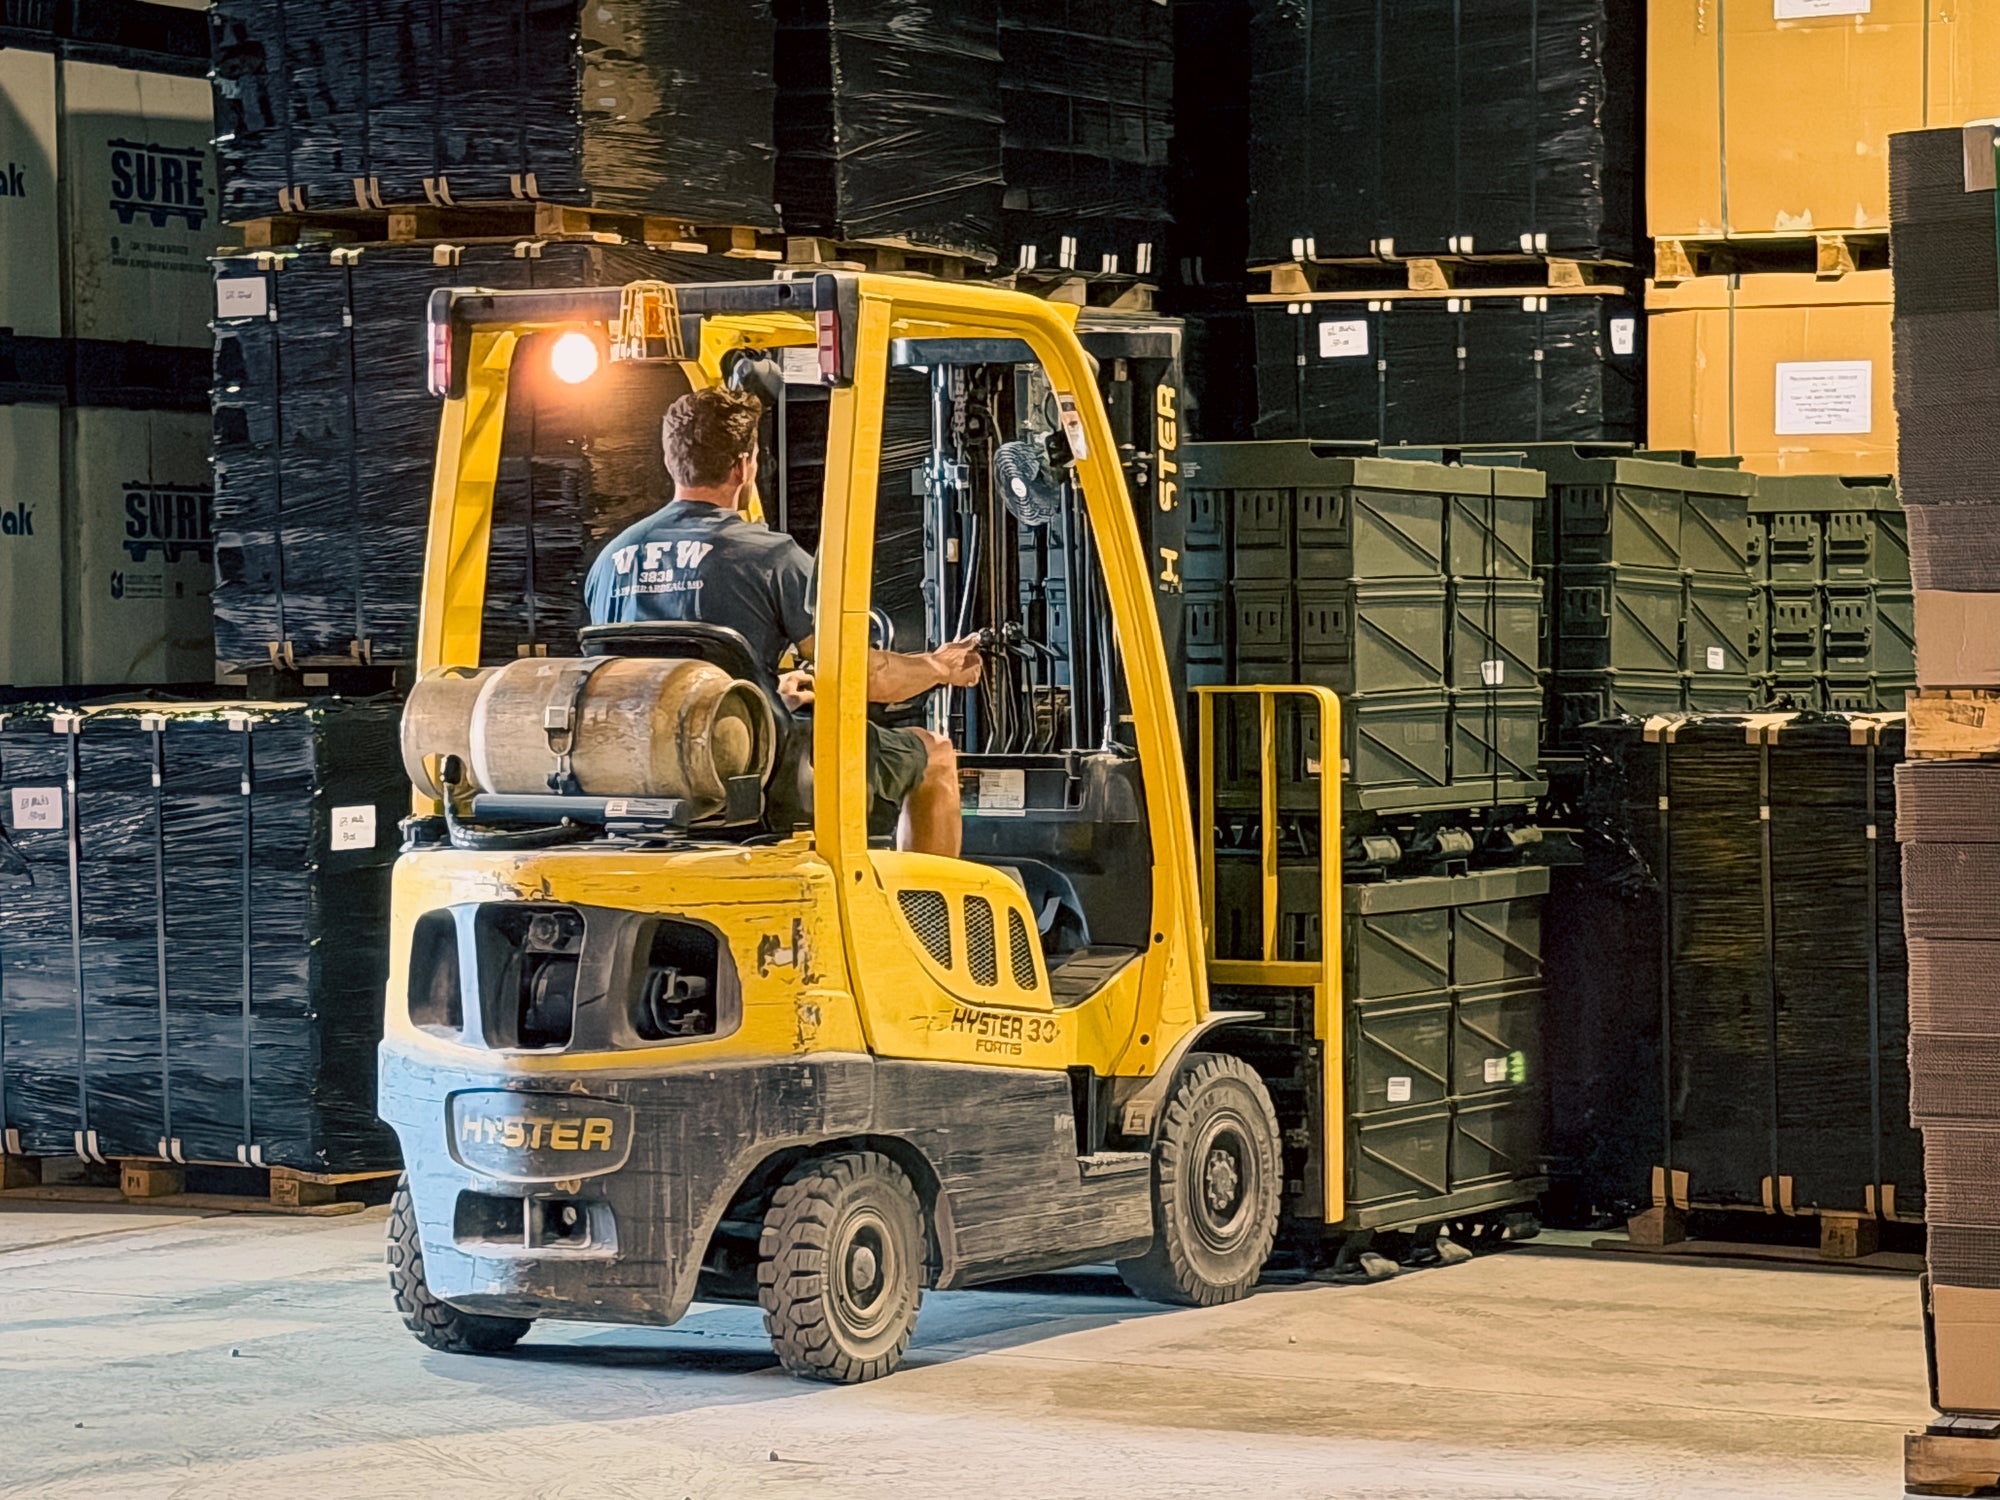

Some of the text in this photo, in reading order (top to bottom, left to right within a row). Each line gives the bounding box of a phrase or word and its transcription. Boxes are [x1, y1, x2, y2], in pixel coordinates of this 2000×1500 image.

[111, 150, 205, 207] SURE
[1156, 383, 1178, 583] HSTER
[0, 502, 34, 536] ak
[611, 541, 713, 574] VFW
[951, 1008, 1023, 1039] HYSTER
[976, 1038, 1022, 1056] FORTIS
[462, 1114, 613, 1151] HYSTER
